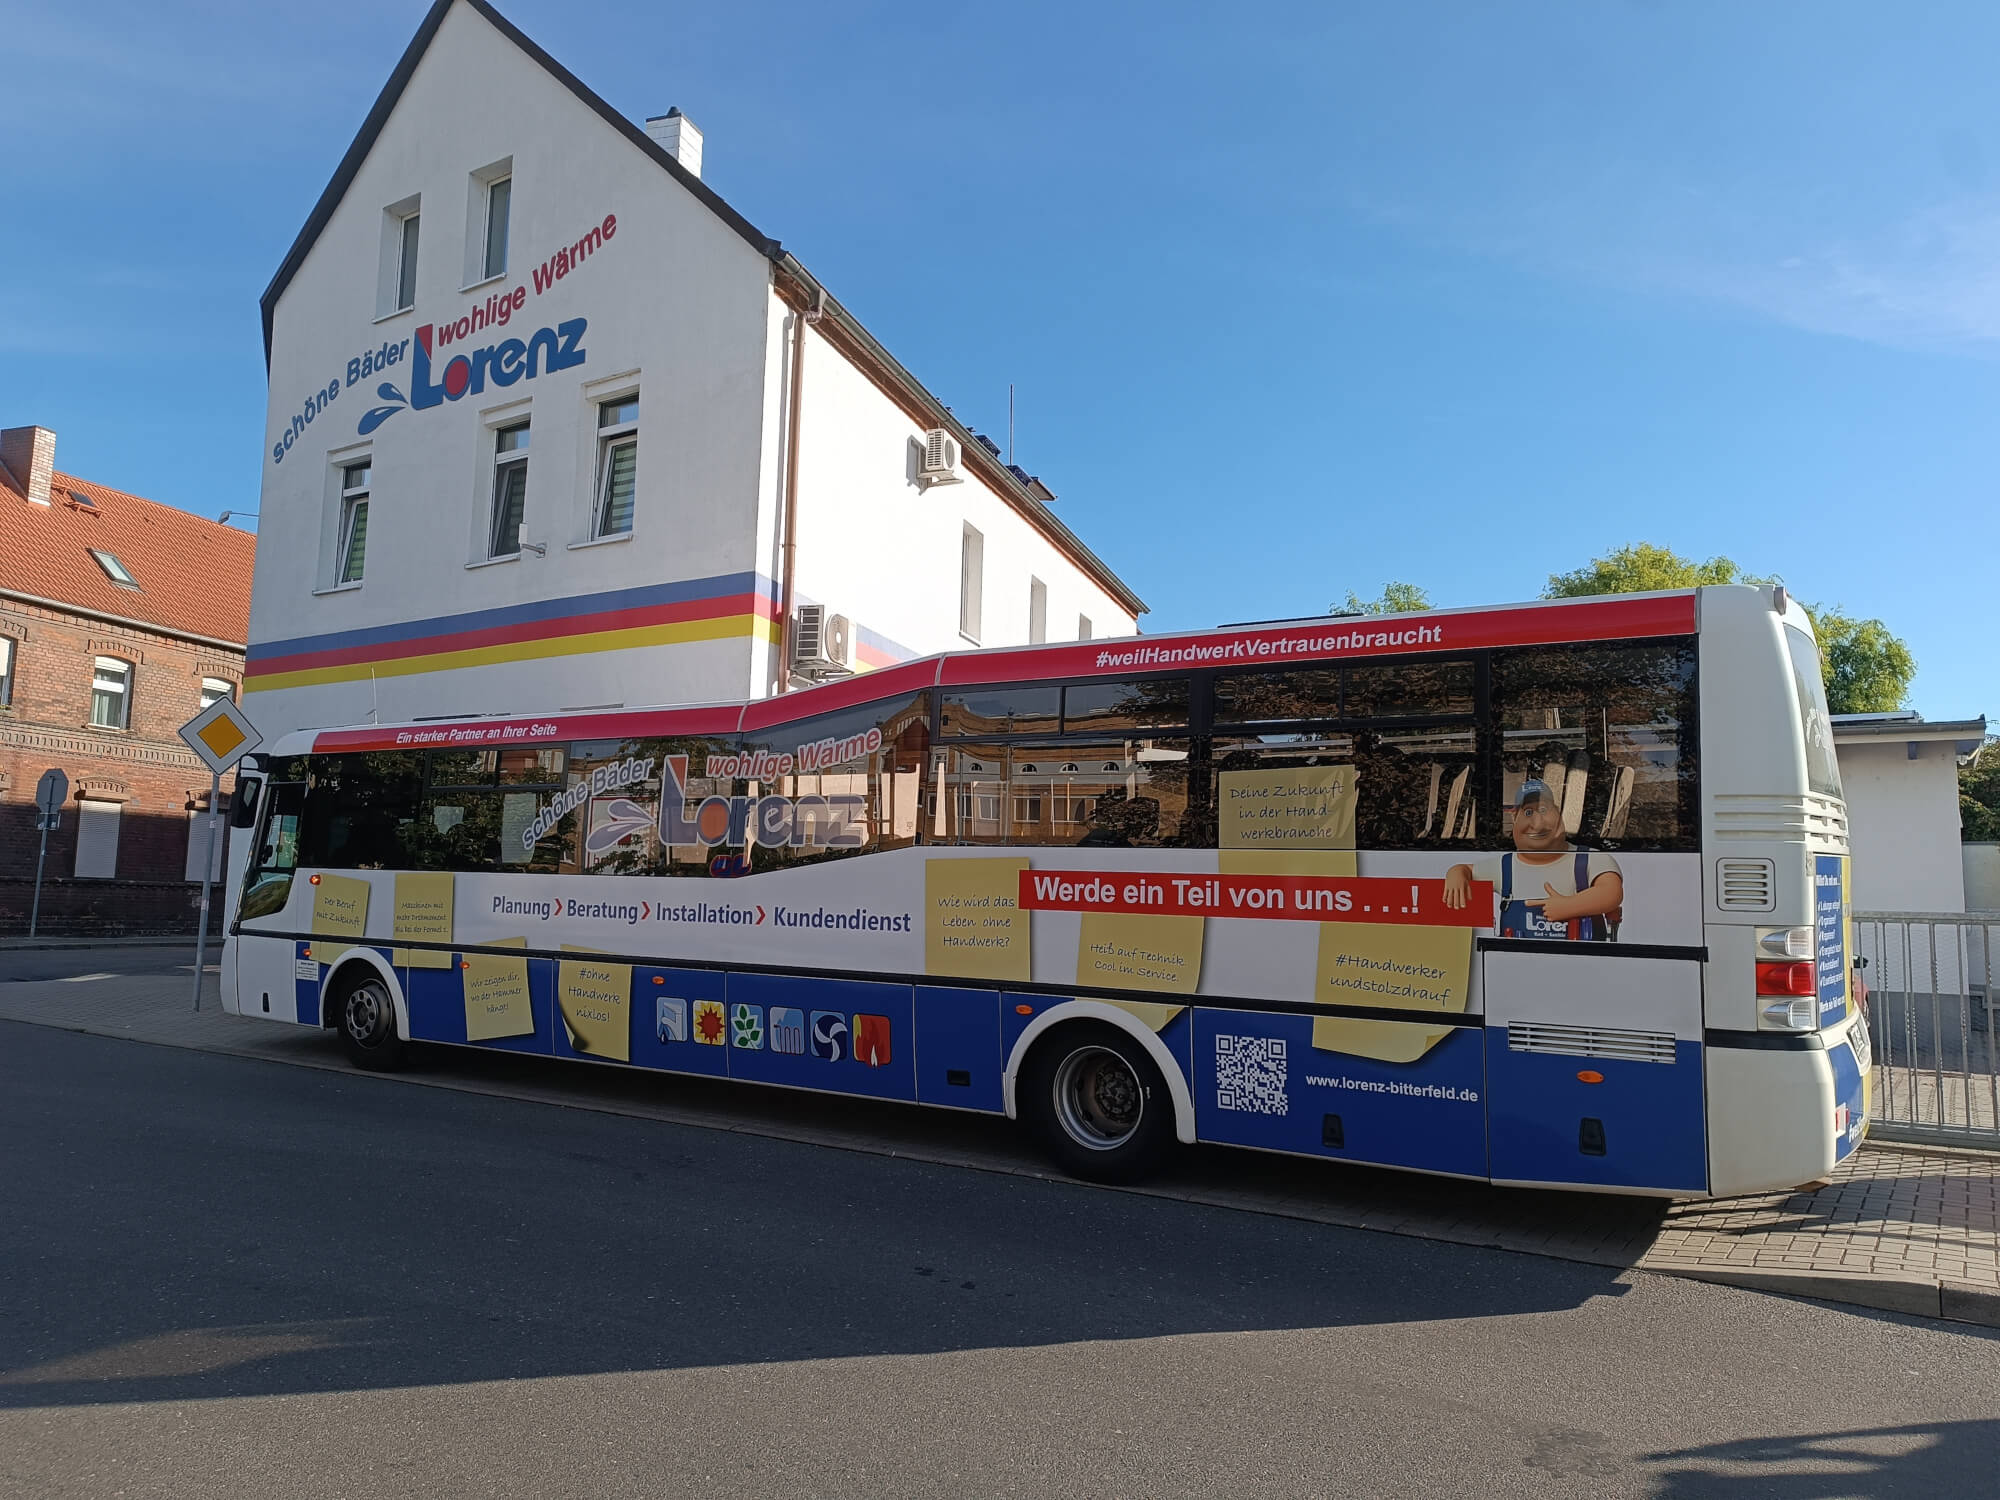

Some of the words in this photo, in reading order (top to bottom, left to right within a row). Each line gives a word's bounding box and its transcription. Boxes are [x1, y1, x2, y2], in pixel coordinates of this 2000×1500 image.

[437, 285, 527, 348] wohlige
[532, 213, 618, 295] Wärme
[410, 317, 588, 411] Lorenz
[273, 376, 340, 465] schöne
[346, 338, 410, 388] Bäder
[1096, 624, 1442, 668] #weilHandwerkVertrauenbraucht
[396, 732, 413, 744] Ein
[414, 731, 448, 743] starker
[449, 728, 486, 741] Partner
[487, 728, 500, 739] an
[503, 725, 528, 738] Ihrer
[529, 723, 557, 736] Seite
[705, 751, 793, 784] wohlige
[798, 727, 882, 770] Wärme
[1230, 784, 1269, 799] Deine
[1273, 780, 1344, 799] Zukunft
[522, 780, 588, 851] schöne
[591, 756, 654, 792] Bäder
[659, 754, 868, 848] Lorenz
[1240, 806, 1255, 818] in
[1259, 805, 1281, 818] der
[1240, 826, 1333, 840] werkbranche
[324, 896, 336, 905] Der
[336, 899, 357, 911] Beruf
[938, 894, 960, 908] Wie
[963, 894, 990, 907] wird
[993, 896, 1015, 907] das
[1034, 876, 1116, 903] Werde
[1123, 879, 1164, 904] ein
[1172, 879, 1220, 907] Teil
[1228, 887, 1284, 909] von
[1295, 889, 1353, 911] uns
[316, 911, 328, 920] mit
[329, 912, 361, 928] Zukunft
[493, 895, 551, 921] Planung
[567, 898, 638, 925] Beratung
[656, 902, 754, 926] Installation
[773, 907, 911, 932] Kundendienst
[942, 915, 977, 927] Leben
[983, 916, 1012, 928] ohne
[943, 935, 1010, 948] Handwerk?
[1090, 942, 1115, 955] Heiß
[1117, 947, 1138, 960] auf
[1140, 951, 1185, 967] Technik
[579, 967, 611, 982] #ohne
[1094, 960, 1117, 972] Cool
[1119, 962, 1134, 974] im
[1335, 953, 1447, 980] #Handwerker
[484, 976, 506, 986] zeigen
[493, 987, 522, 998] Hammer
[568, 986, 621, 1005] Handwerk
[1330, 976, 1452, 1007] undstolzdrauf
[576, 1005, 610, 1023] nixlos!
[1305, 1074, 1479, 1102] www.lorenz-bitterfeld.de
